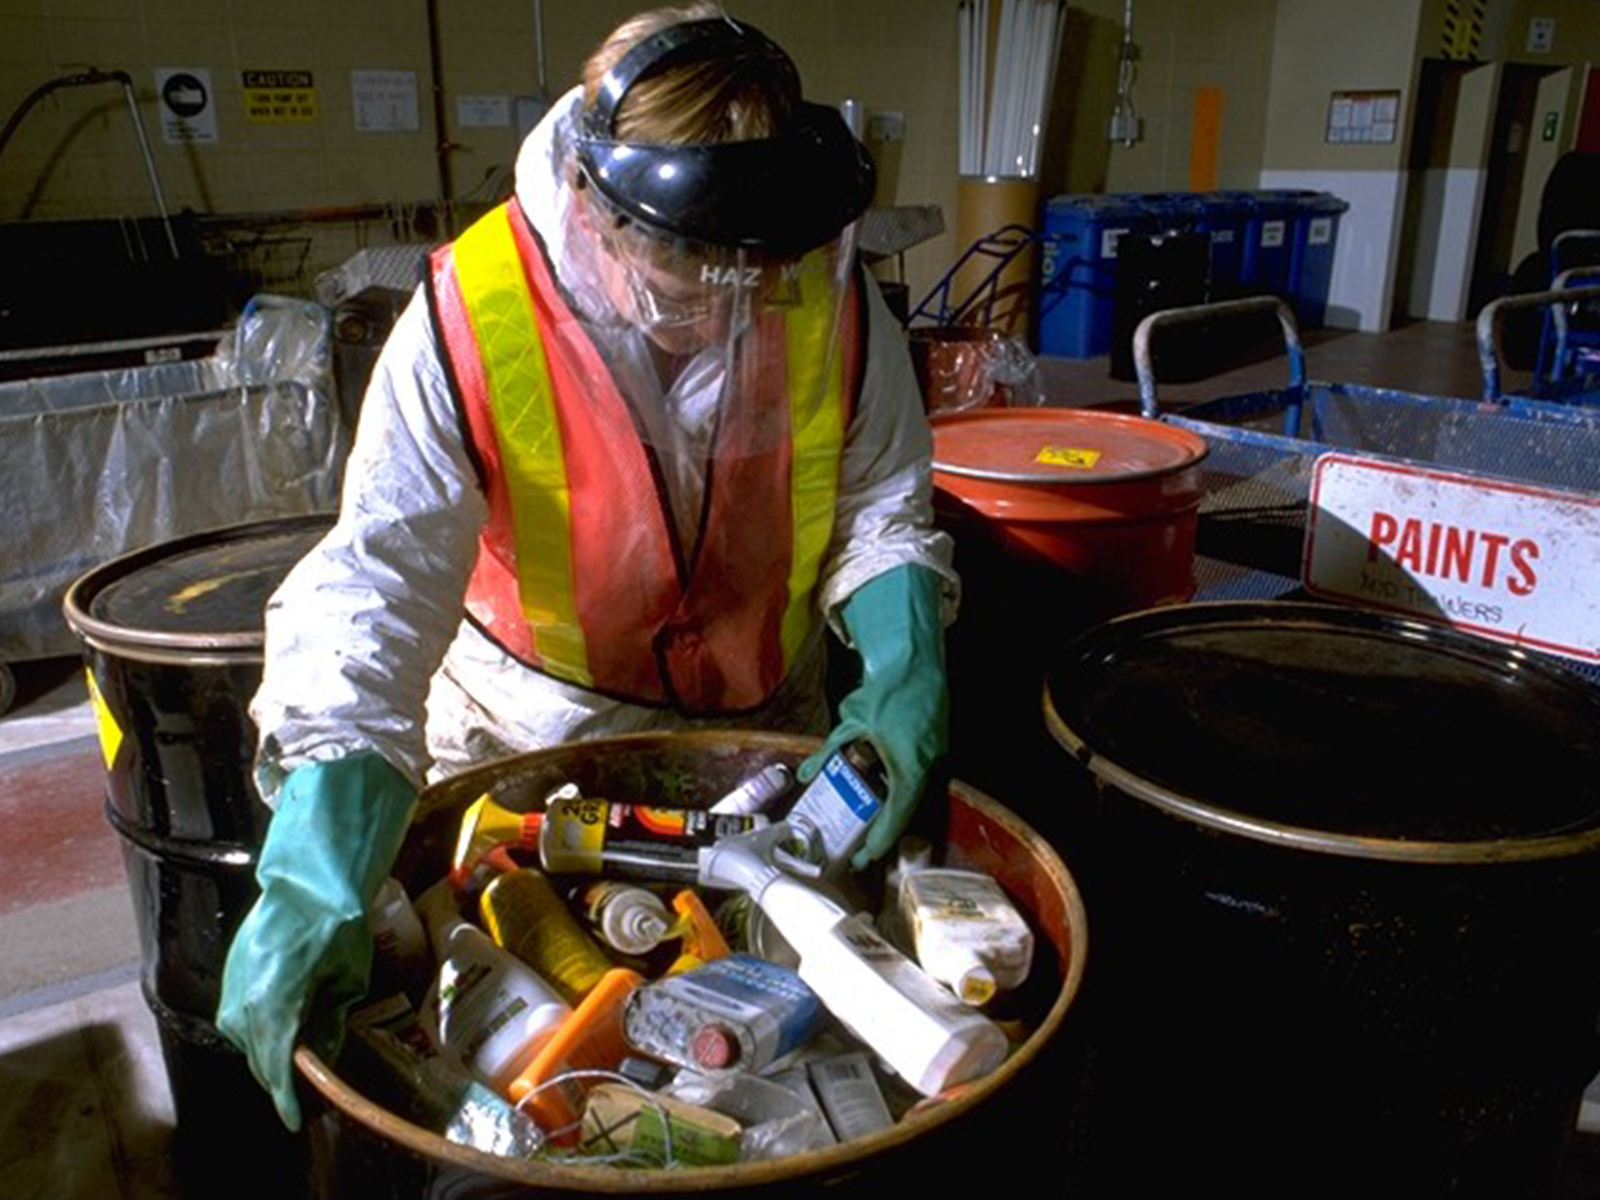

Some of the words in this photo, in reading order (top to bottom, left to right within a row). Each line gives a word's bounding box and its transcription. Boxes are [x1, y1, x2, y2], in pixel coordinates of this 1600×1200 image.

[246, 73, 310, 86] CAUTION
[700, 263, 762, 287] HAZ
[1367, 511, 1541, 596] PAINTS
